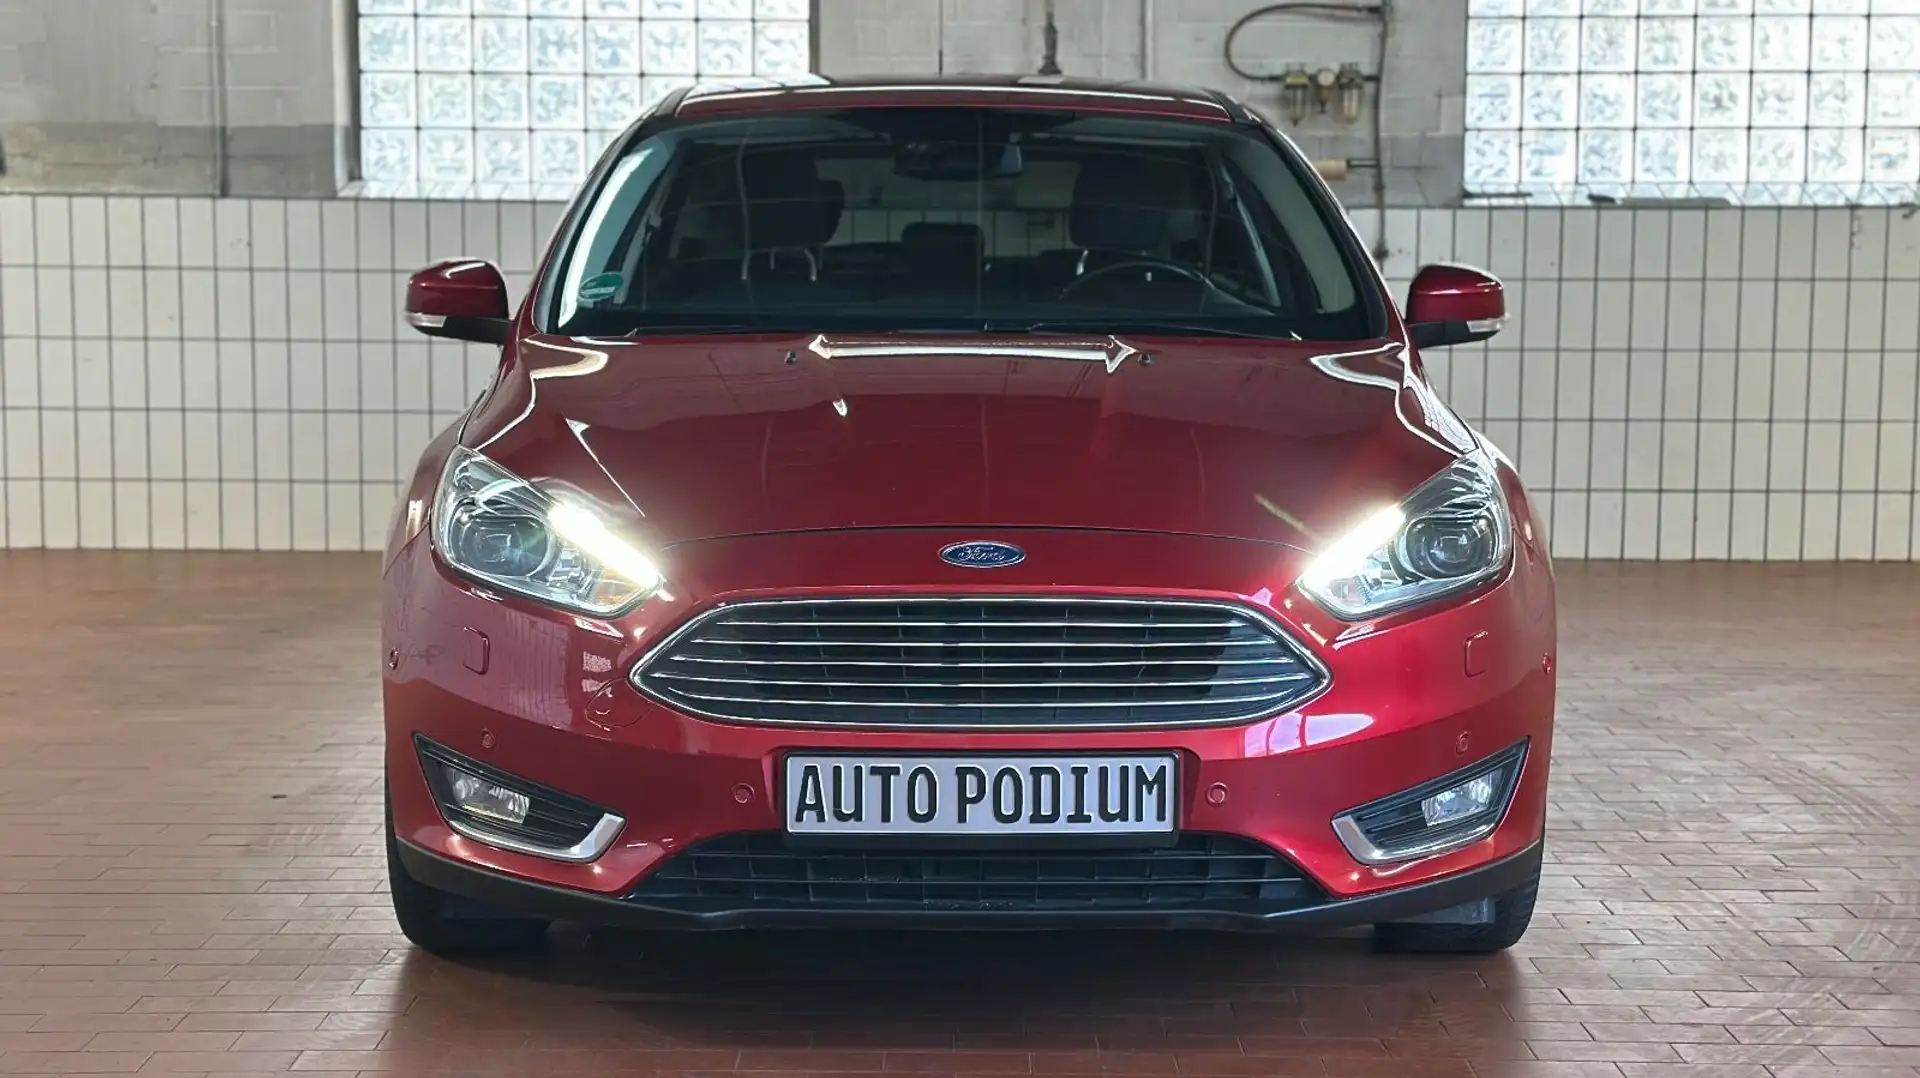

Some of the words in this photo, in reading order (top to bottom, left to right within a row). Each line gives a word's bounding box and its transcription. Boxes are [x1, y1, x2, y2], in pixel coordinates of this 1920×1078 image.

[957, 546, 1005, 561] Ford
[795, 764, 938, 824] AUTO
[955, 764, 1168, 824] PODIUM
